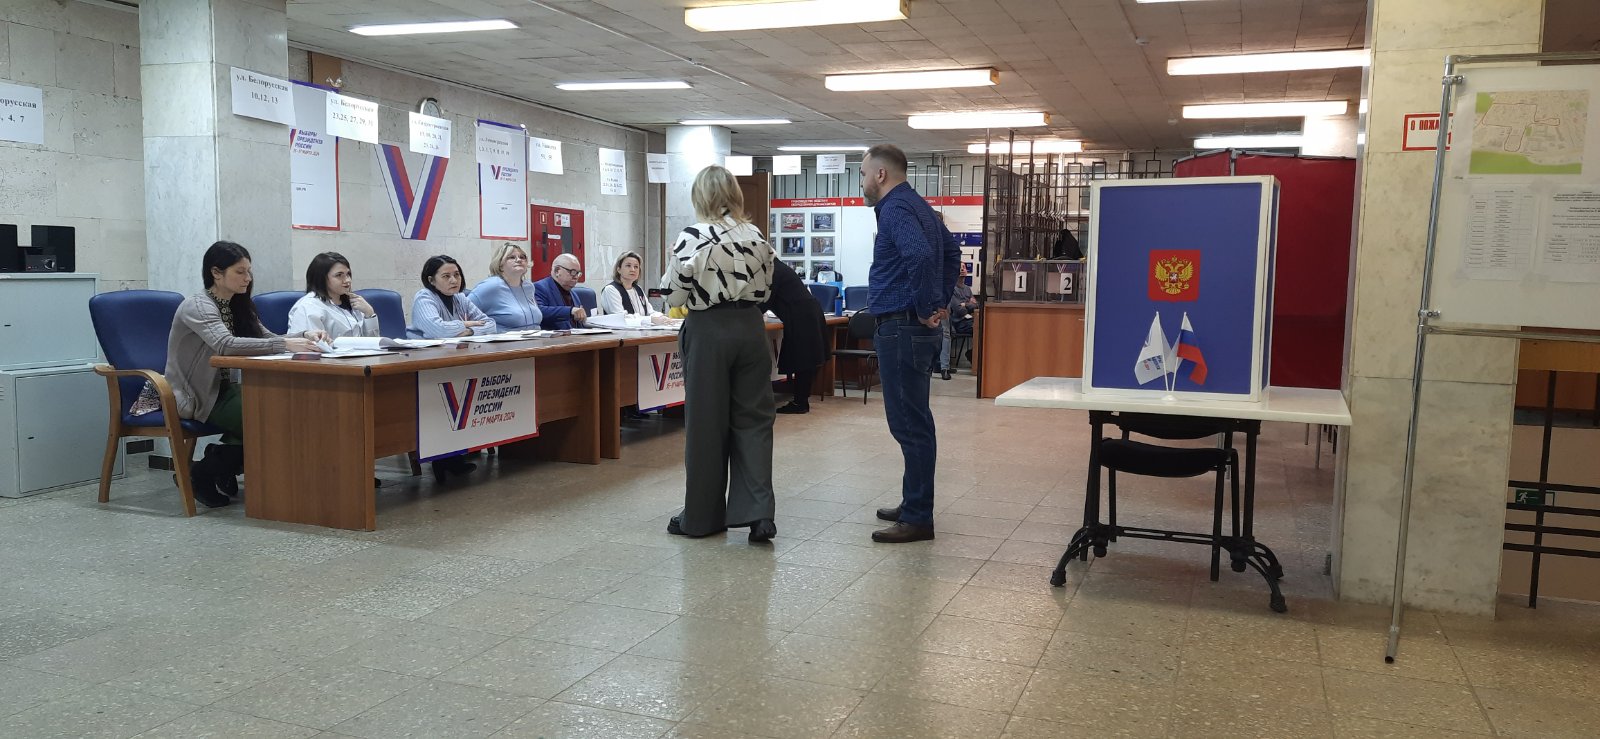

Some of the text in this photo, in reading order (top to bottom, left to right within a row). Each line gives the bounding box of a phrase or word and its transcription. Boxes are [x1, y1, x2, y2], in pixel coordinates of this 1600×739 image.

[236, 74, 289, 91] ул. Белорусская
[1419, 119, 1440, 131] ПОЖА
[1017, 275, 1024, 289] 1
[1063, 276, 1072, 291] 2
[481, 374, 512, 387] ВЫБОРЫ
[477, 385, 520, 401] ПРЕЗИДЕНТА
[473, 401, 504, 416] РОССИИ
[486, 413, 503, 425] МАРТА
[503, 411, 516, 421] 2024
